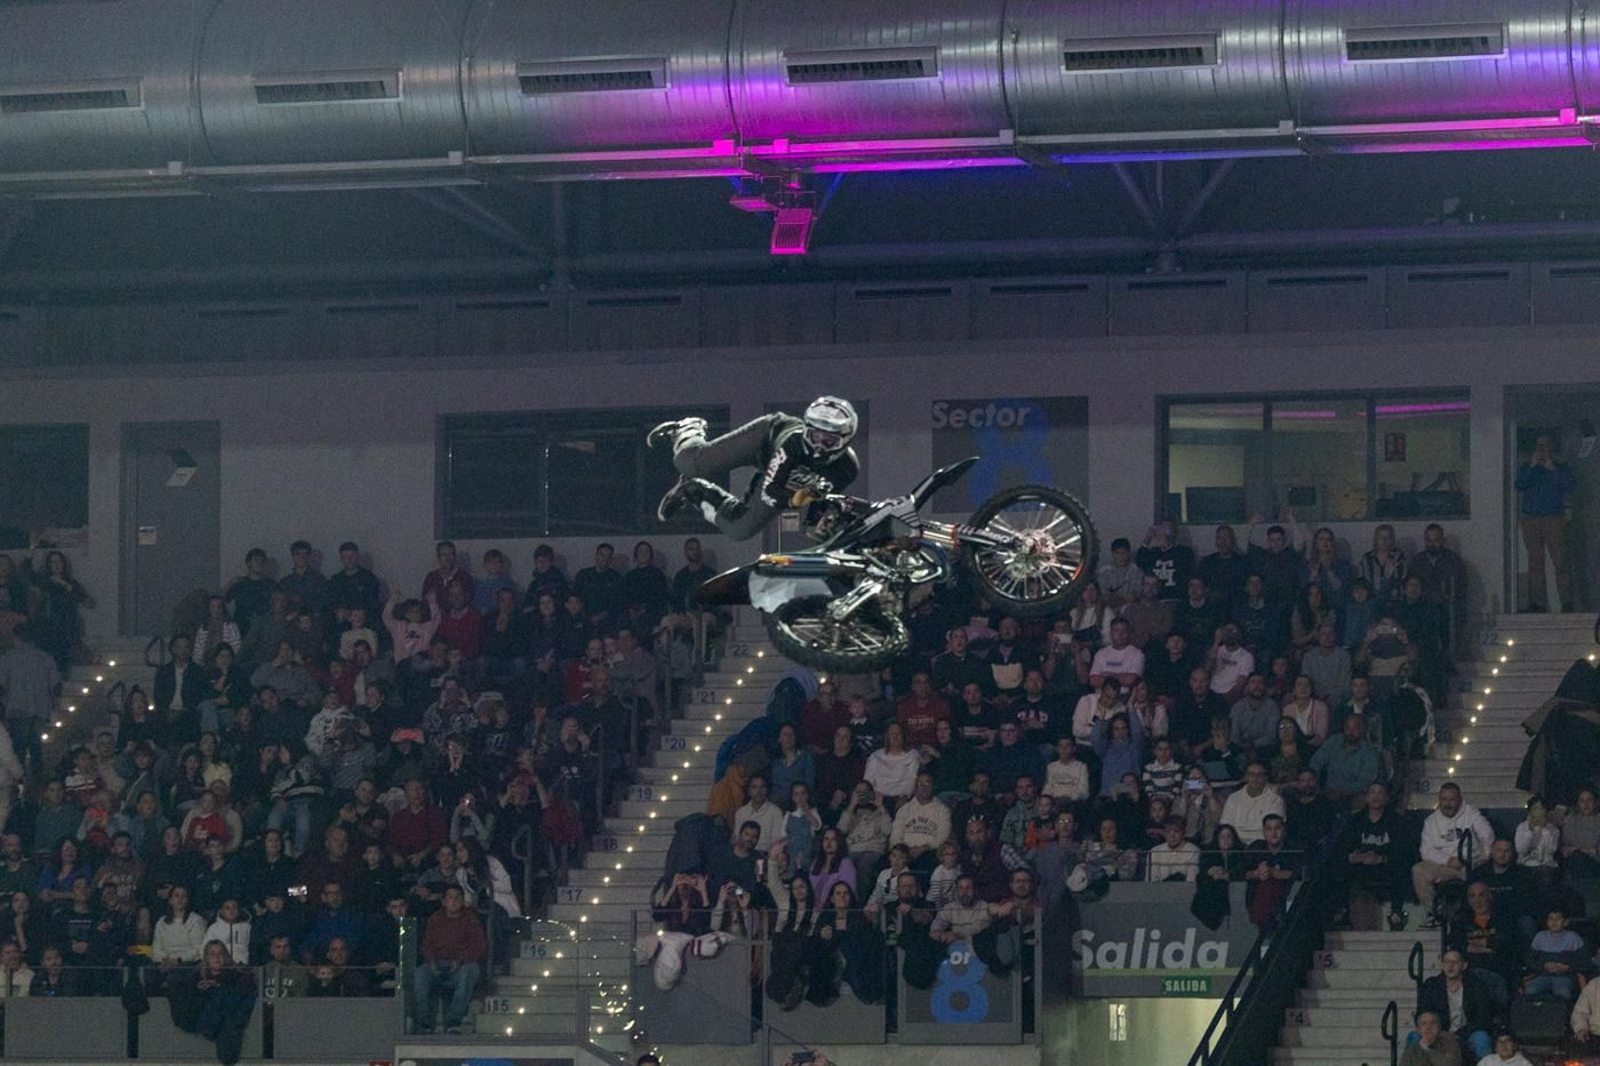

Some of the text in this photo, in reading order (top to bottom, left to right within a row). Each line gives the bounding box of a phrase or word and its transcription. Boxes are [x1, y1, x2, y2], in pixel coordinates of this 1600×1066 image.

[932, 401, 1032, 429] Sector
[733, 644, 749, 655] 22
[701, 691, 716, 703] 21
[670, 738, 686, 750] 20
[637, 788, 652, 800] 19
[603, 839, 618, 851] 18
[566, 889, 581, 901] 17
[530, 945, 546, 957] 16
[1071, 927, 1230, 969] Salida
[1323, 953, 1334, 968] 5
[931, 940, 989, 1025] 8
[1165, 979, 1208, 992] SALIDA
[494, 1000, 509, 1012] 15
